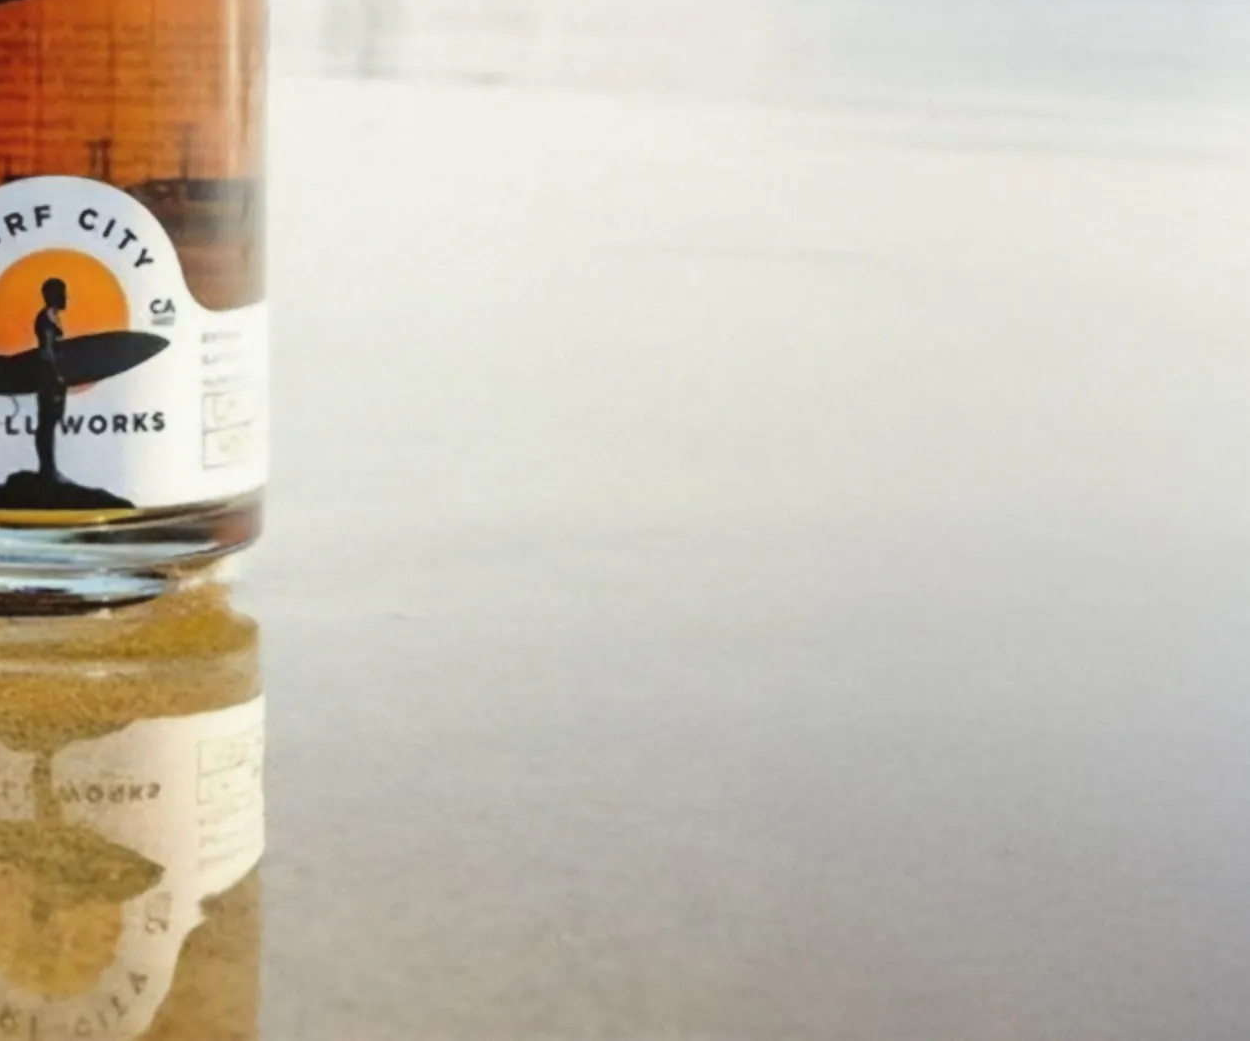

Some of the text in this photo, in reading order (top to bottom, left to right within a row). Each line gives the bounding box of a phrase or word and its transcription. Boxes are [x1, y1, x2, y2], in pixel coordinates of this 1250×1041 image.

[78, 208, 154, 269] CITY
[149, 298, 176, 315] CA
[57, 411, 166, 435] WORKS
